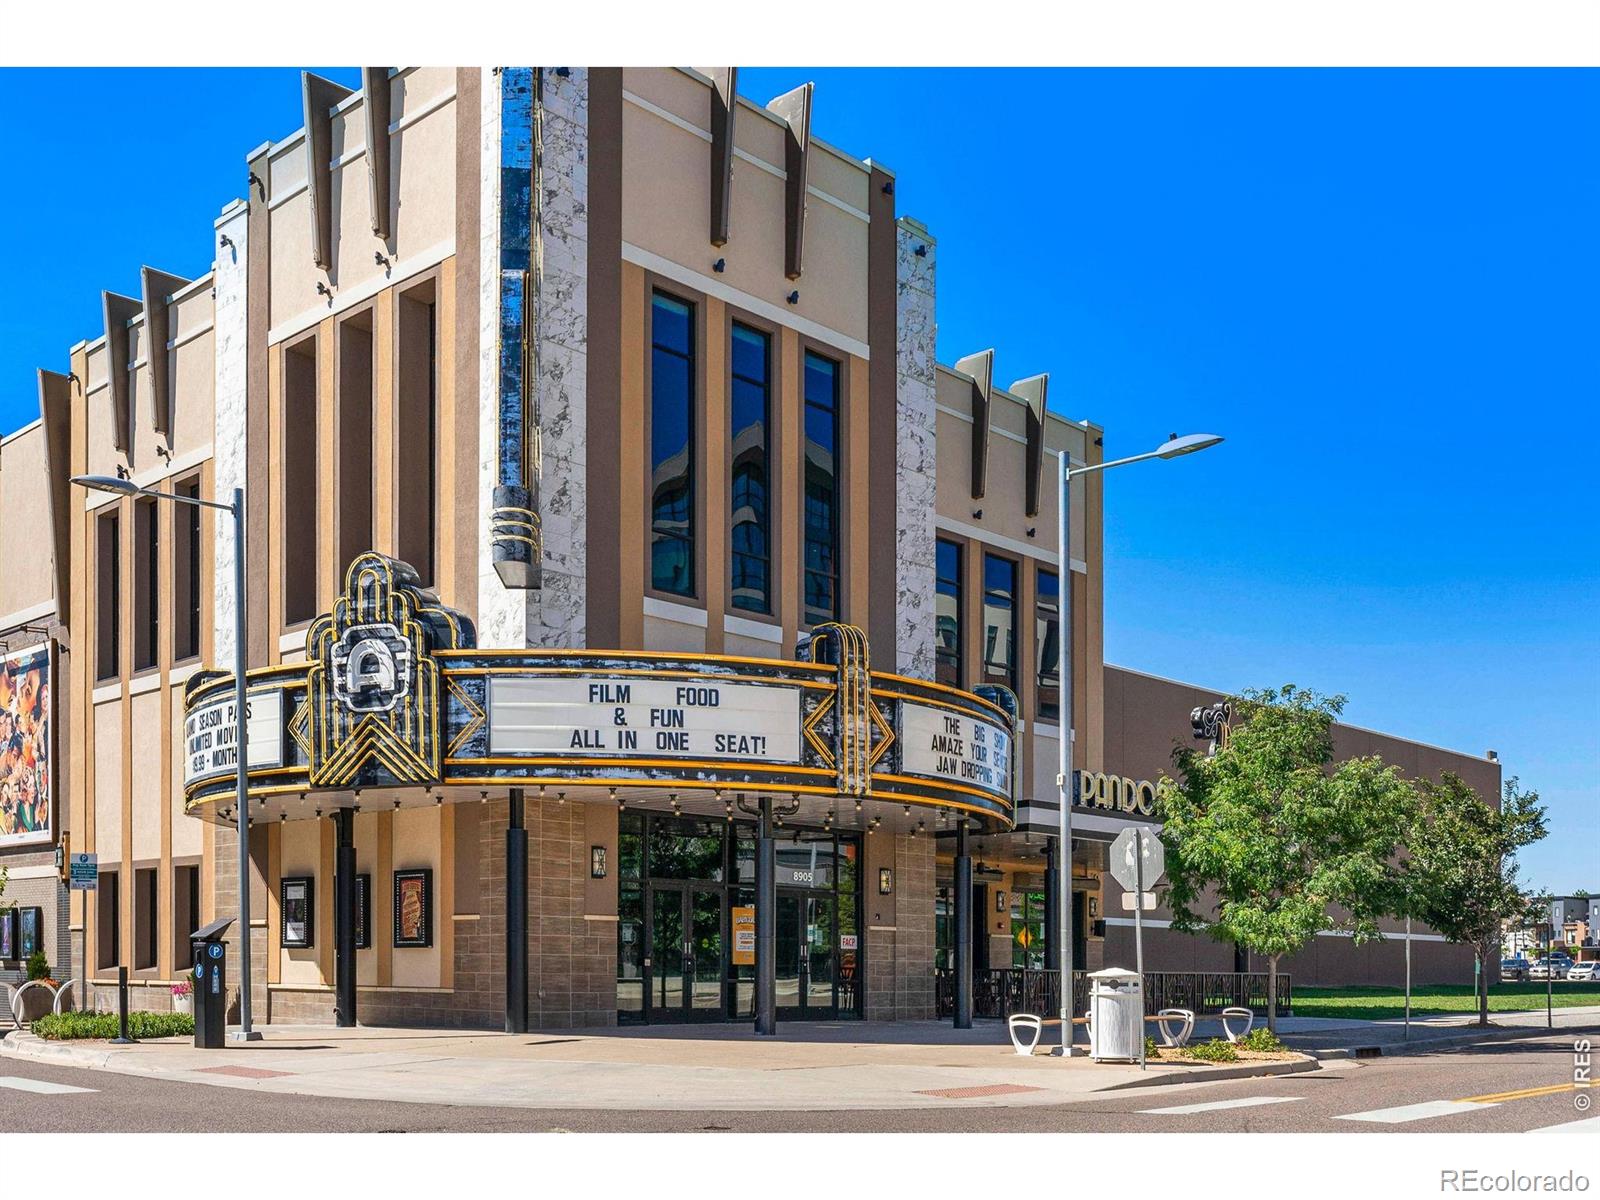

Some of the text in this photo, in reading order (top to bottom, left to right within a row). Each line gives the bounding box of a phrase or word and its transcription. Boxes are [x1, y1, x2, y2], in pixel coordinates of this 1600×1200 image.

[588, 684, 720, 707] FILM FOOD
[199, 707, 223, 731] SEASON
[228, 702, 252, 723] PAS
[614, 707, 685, 728] & FUN
[943, 716, 960, 736] THE
[974, 724, 985, 743] BIG
[570, 729, 766, 755] ALL IN ONE SEAT!
[931, 734, 963, 757] AMAZE
[971, 742, 987, 763] YOUR
[936, 756, 957, 775] JAW
[961, 760, 993, 784] DROPPING
[793, 871, 813, 881] 8905
